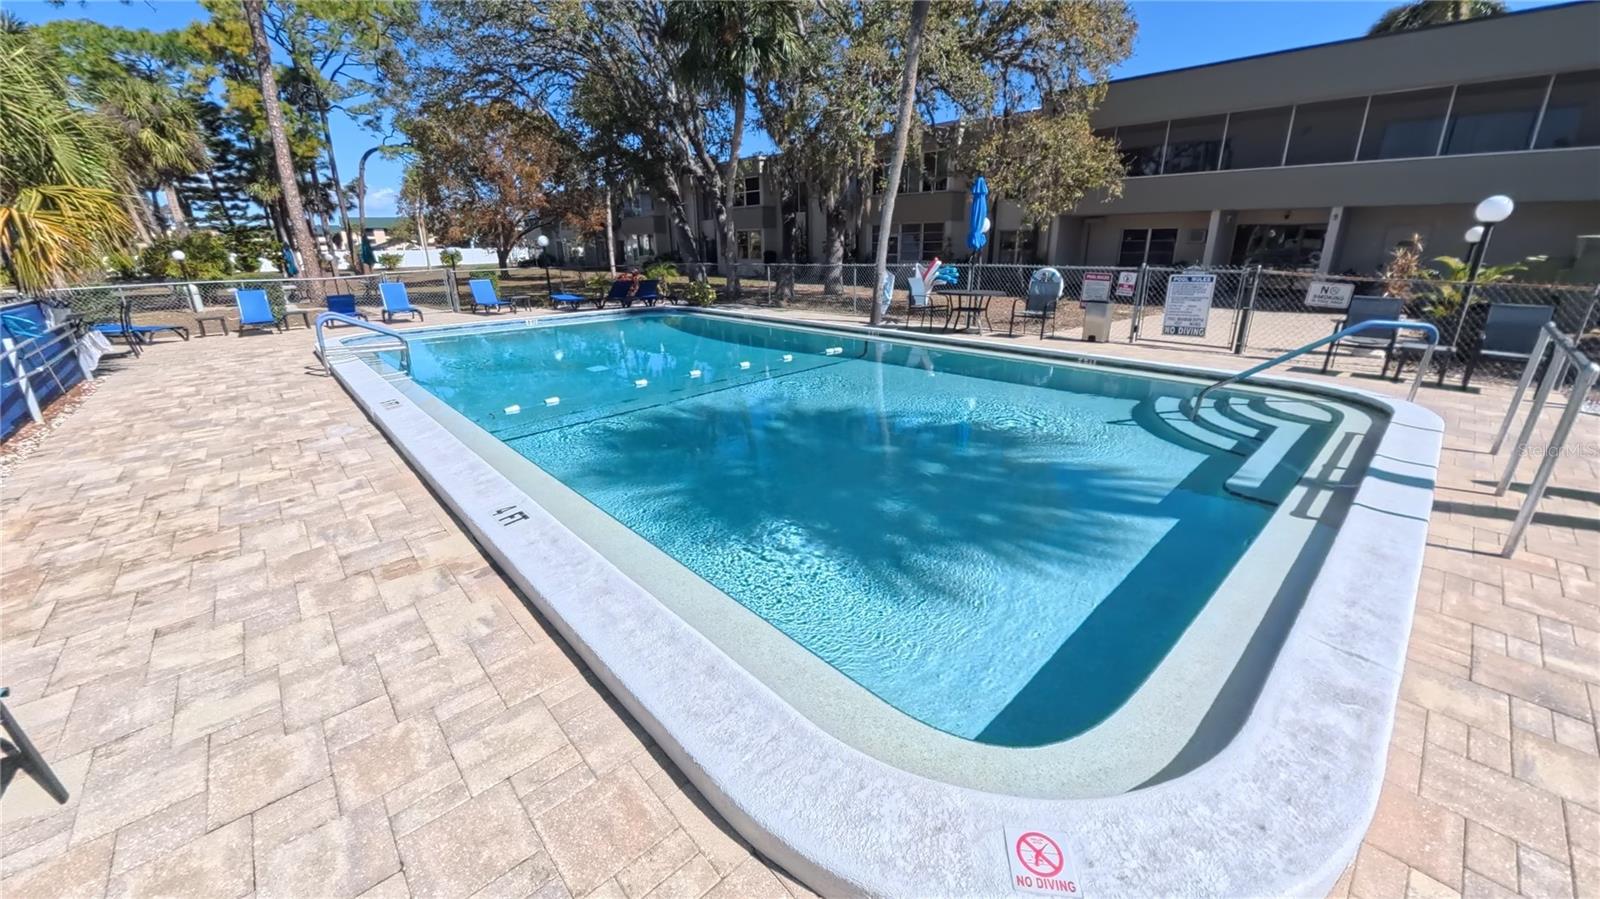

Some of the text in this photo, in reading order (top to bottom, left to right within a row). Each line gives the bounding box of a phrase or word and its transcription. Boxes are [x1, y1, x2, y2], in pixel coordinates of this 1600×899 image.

[1178, 327, 1205, 336] DIVING
[498, 511, 530, 527] FT
[1016, 875, 1077, 893] NO DIVING
